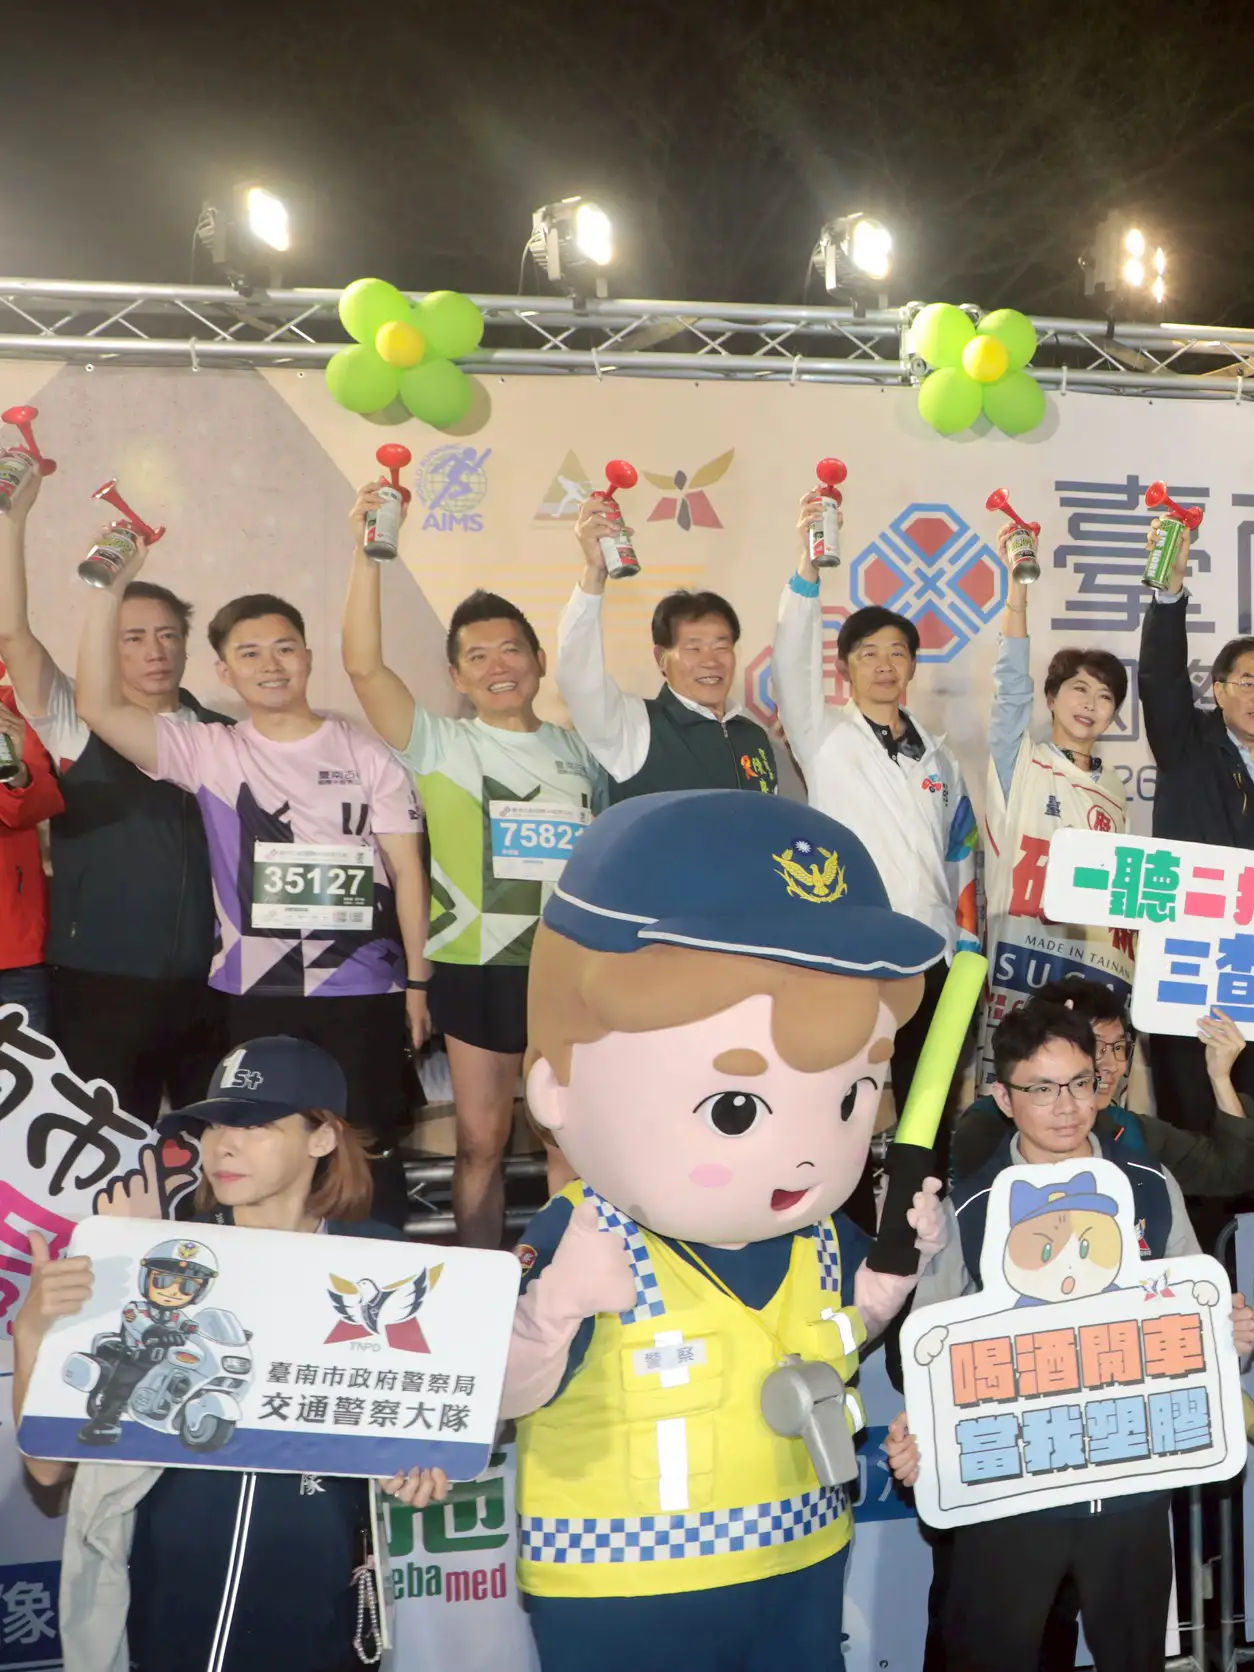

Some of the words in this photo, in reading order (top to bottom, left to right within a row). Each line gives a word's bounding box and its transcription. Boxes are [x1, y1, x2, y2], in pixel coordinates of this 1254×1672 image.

[421, 512, 484, 532] AIMS
[499, 822, 585, 851] 7582
[263, 866, 366, 896] 35127
[1024, 934, 1065, 954] MADE
[1068, 944, 1084, 961] IN
[1090, 953, 1131, 979] TAINAN
[265, 1361, 476, 1397] 臺南市政府警察局
[949, 1312, 1207, 1409] 喝酒開車
[257, 1391, 471, 1433] 交通警察大隊
[390, 1561, 508, 1603] ebamed
